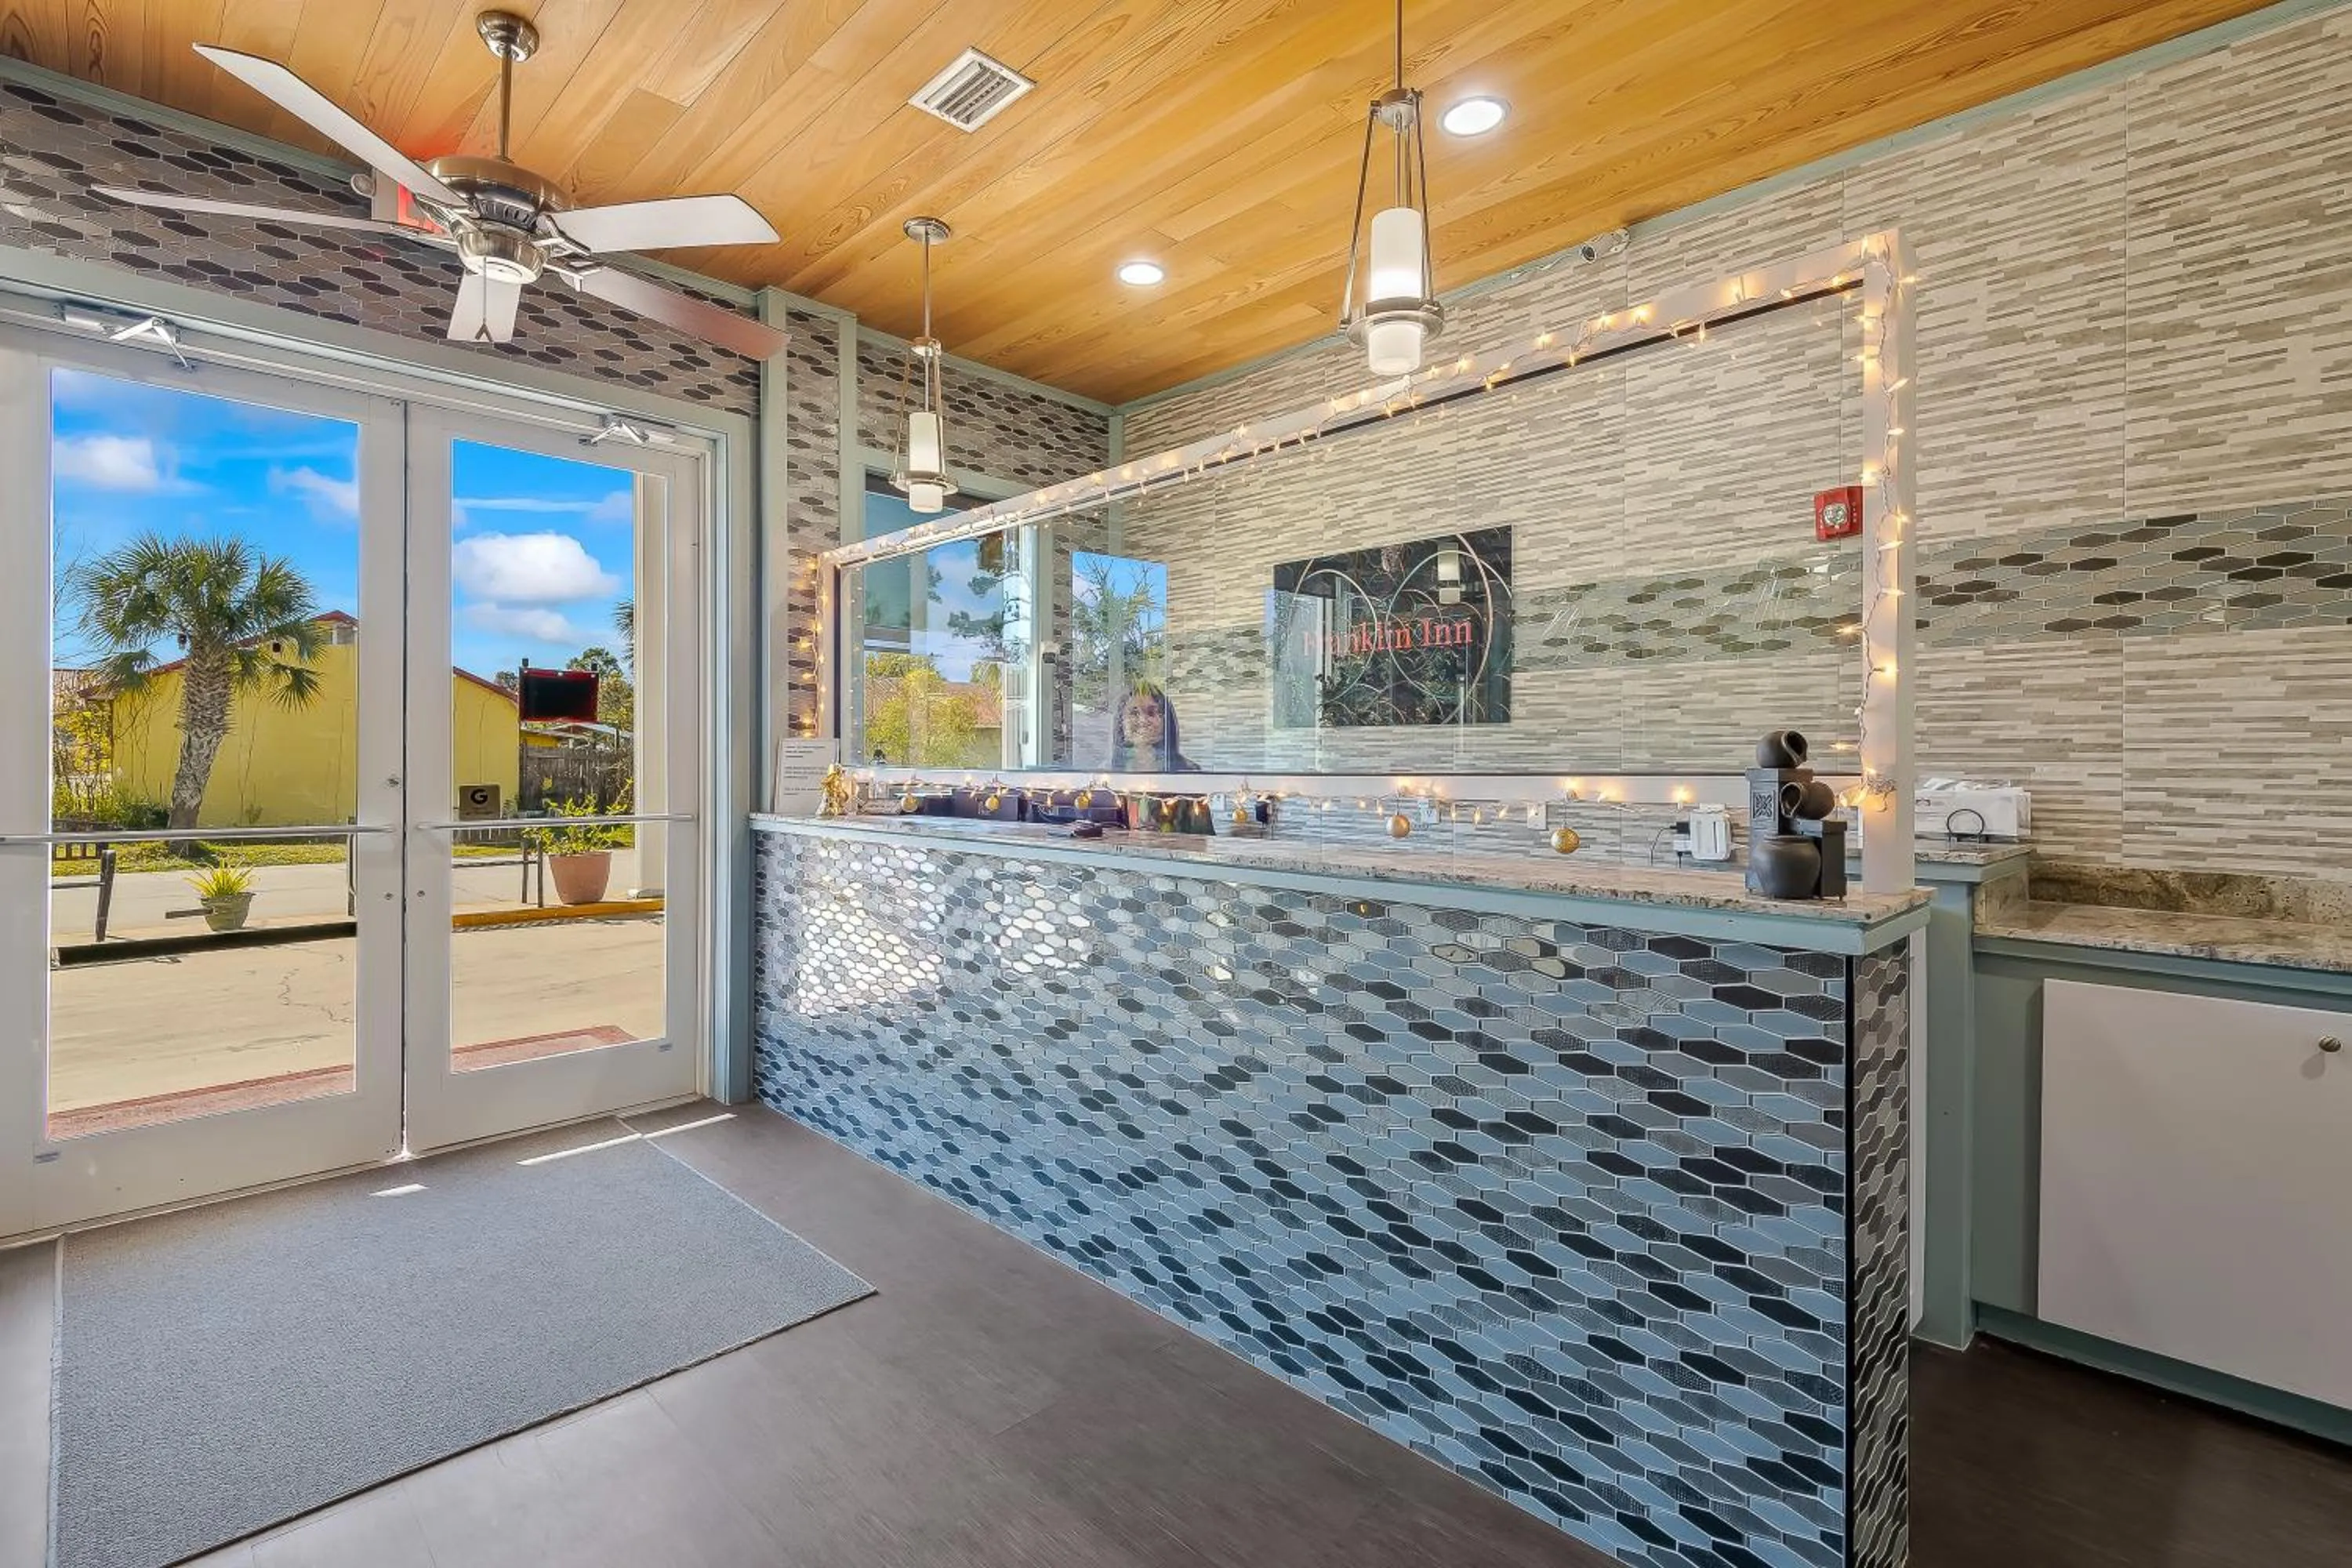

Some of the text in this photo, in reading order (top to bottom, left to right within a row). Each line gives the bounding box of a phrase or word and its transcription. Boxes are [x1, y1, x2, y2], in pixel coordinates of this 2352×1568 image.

[1302, 616, 1472, 657] Fanklin Inn
[470, 788, 488, 805] G
